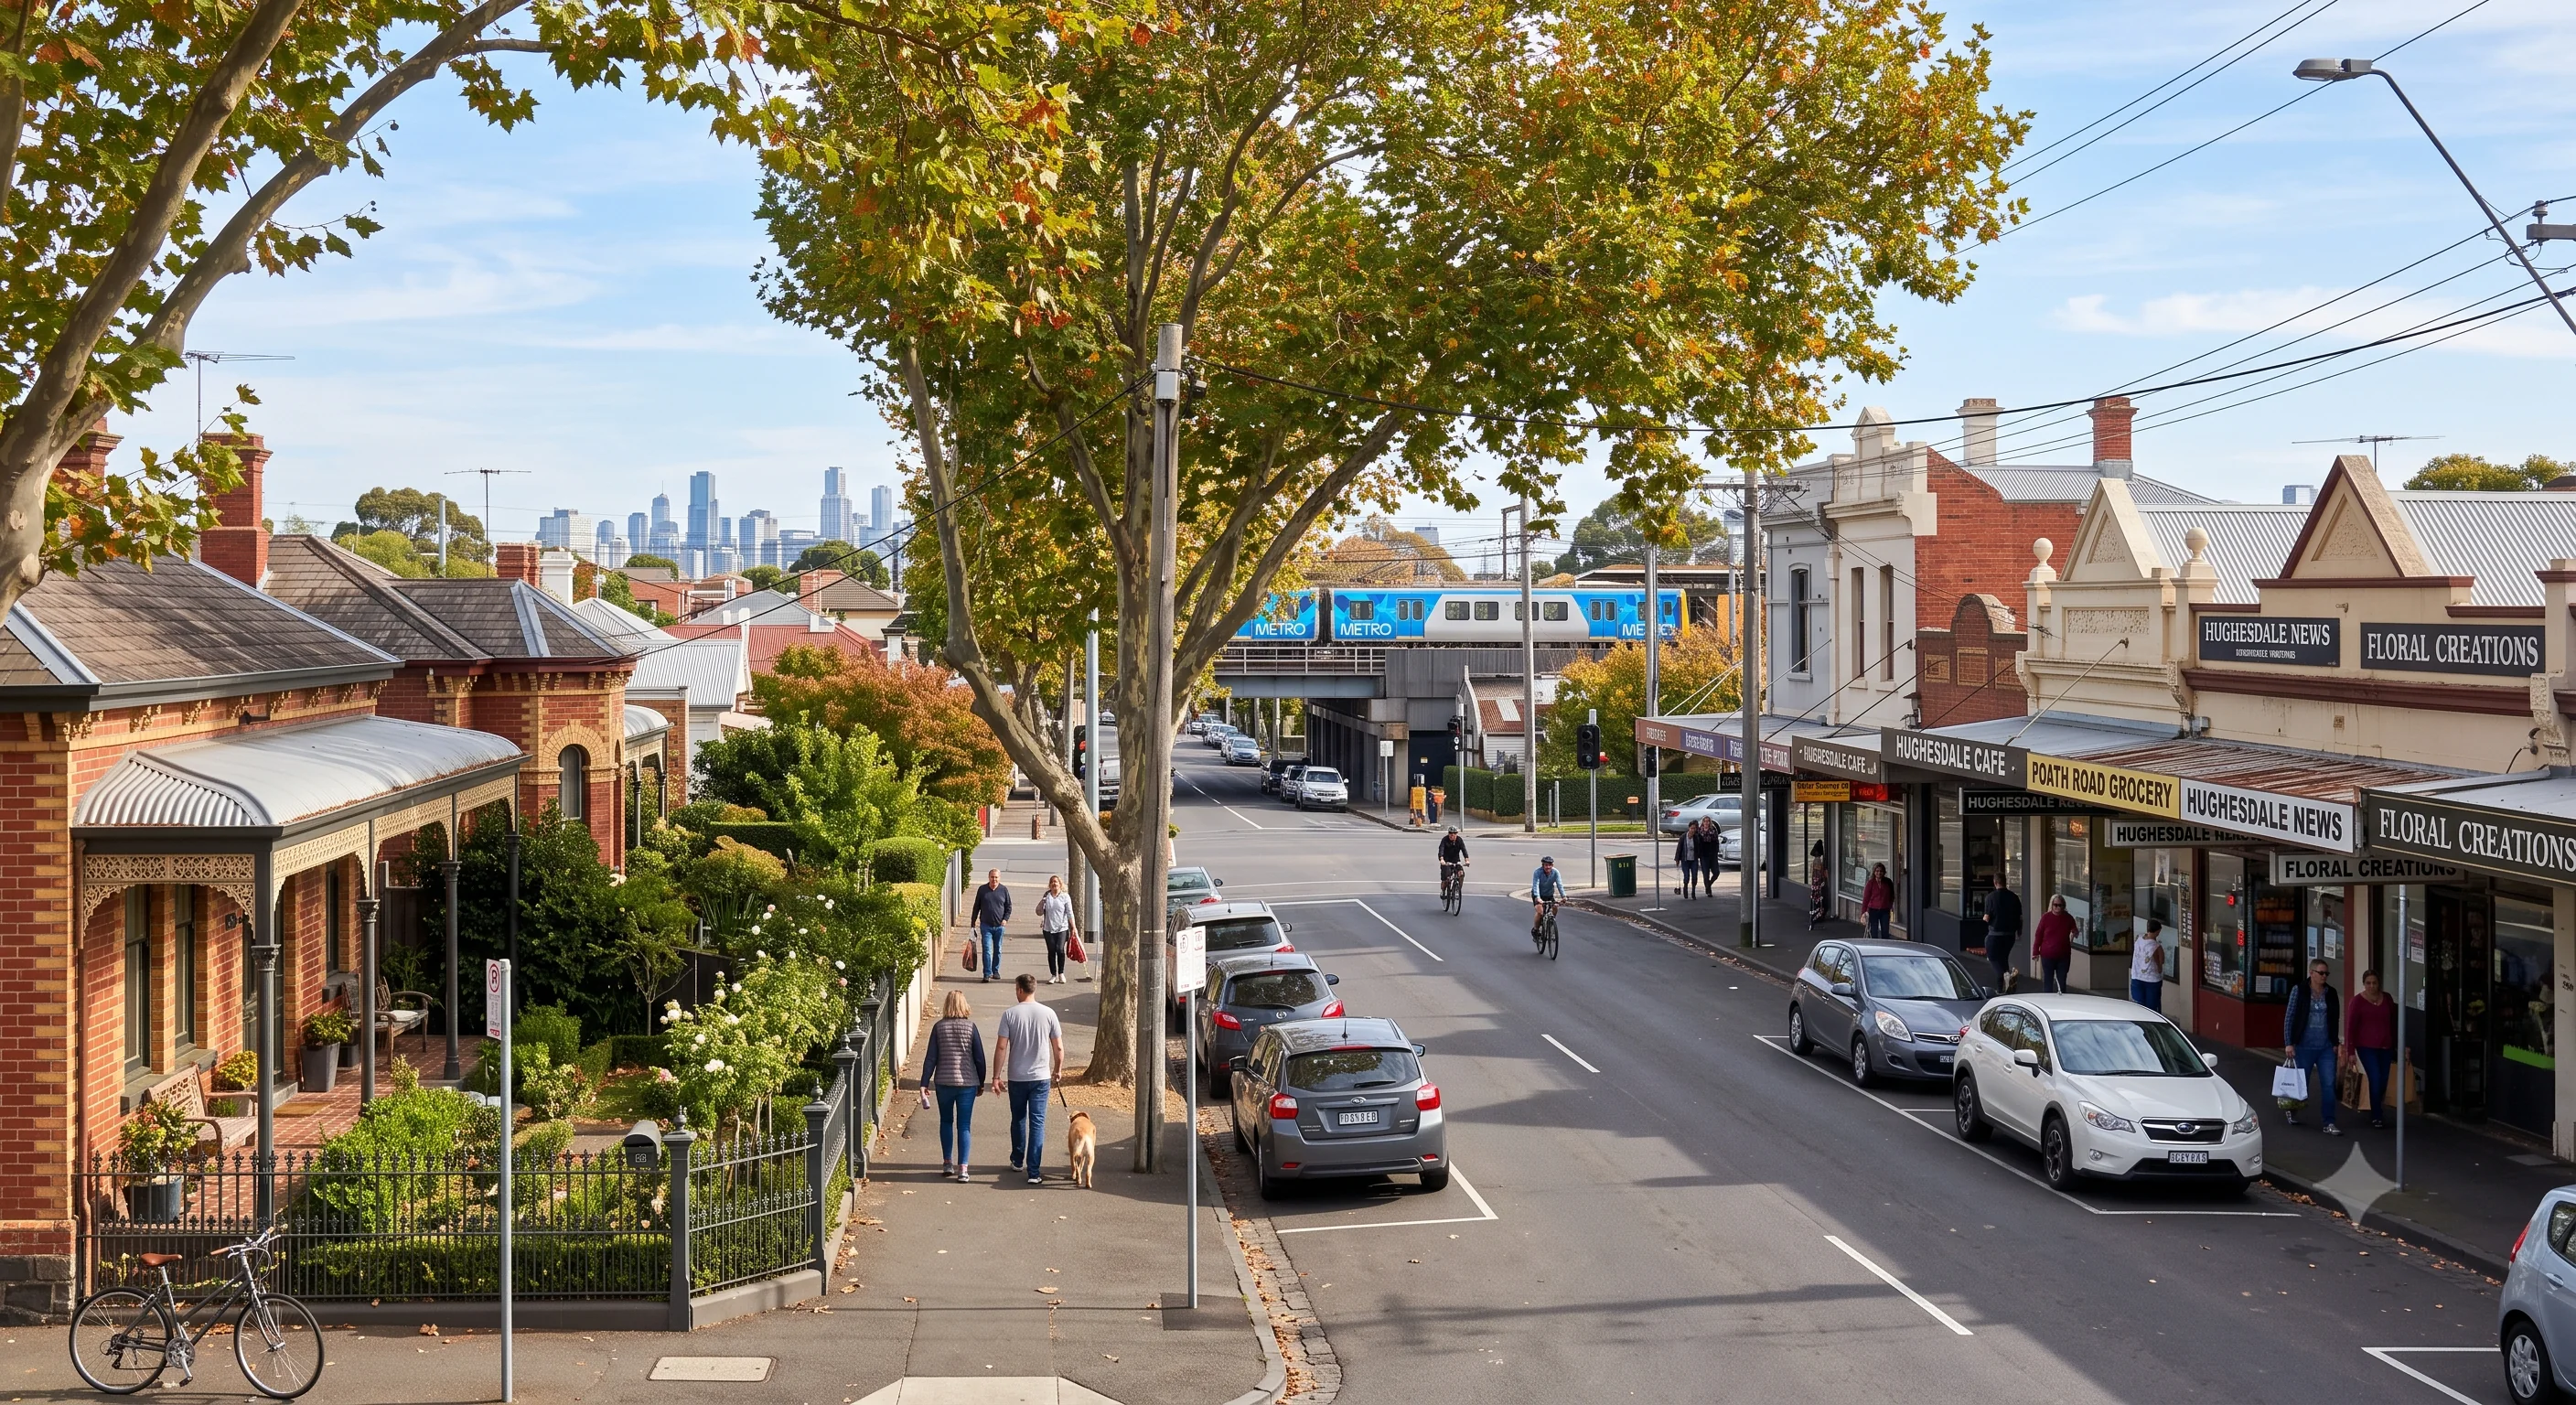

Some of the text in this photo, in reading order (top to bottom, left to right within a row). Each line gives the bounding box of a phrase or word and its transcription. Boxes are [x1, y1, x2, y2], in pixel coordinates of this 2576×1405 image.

[1255, 623, 1306, 636] METRO
[1340, 623, 1392, 636] METRO
[2205, 622, 2331, 646] HUGHESDALE NEWS
[2367, 633, 2539, 667] FLORAL CREATIONS
[1848, 754, 1866, 774] CAFE
[1896, 735, 2006, 776] HUGHESDALE CAFE
[2032, 761, 2173, 809] POATH ROAD GROCERY
[1969, 797, 2055, 809] HUGHESDALE
[2187, 788, 2343, 842] HUGHESDALE NEWS
[2117, 826, 2210, 842] HUGHESDALE
[2379, 808, 2576, 873] FLORAL CREATIONS
[2286, 860, 2353, 878] FLORAL
